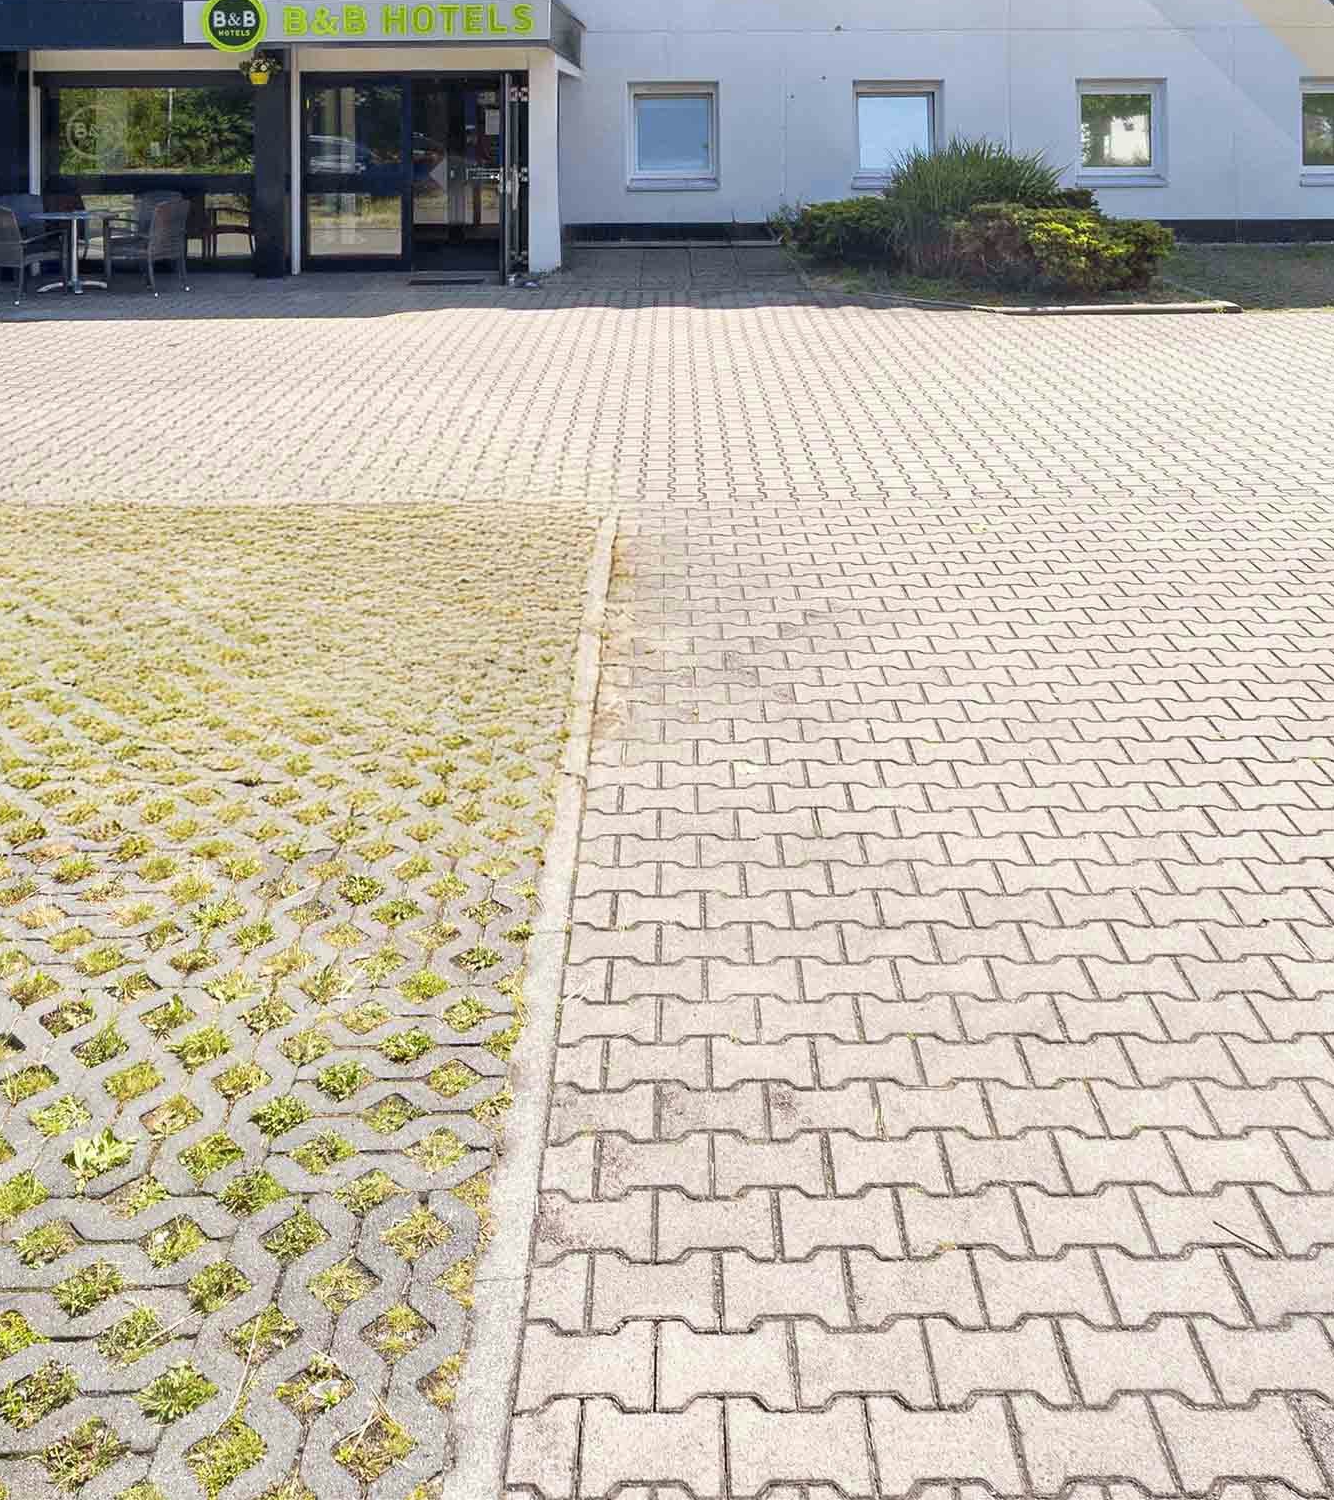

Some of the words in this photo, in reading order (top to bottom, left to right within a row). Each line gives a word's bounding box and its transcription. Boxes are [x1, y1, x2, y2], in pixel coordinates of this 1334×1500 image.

[213, 10, 257, 28] B&B
[283, 5, 366, 36] B&B
[381, 3, 535, 35] HOTELS
[218, 29, 251, 37] HOTELS
